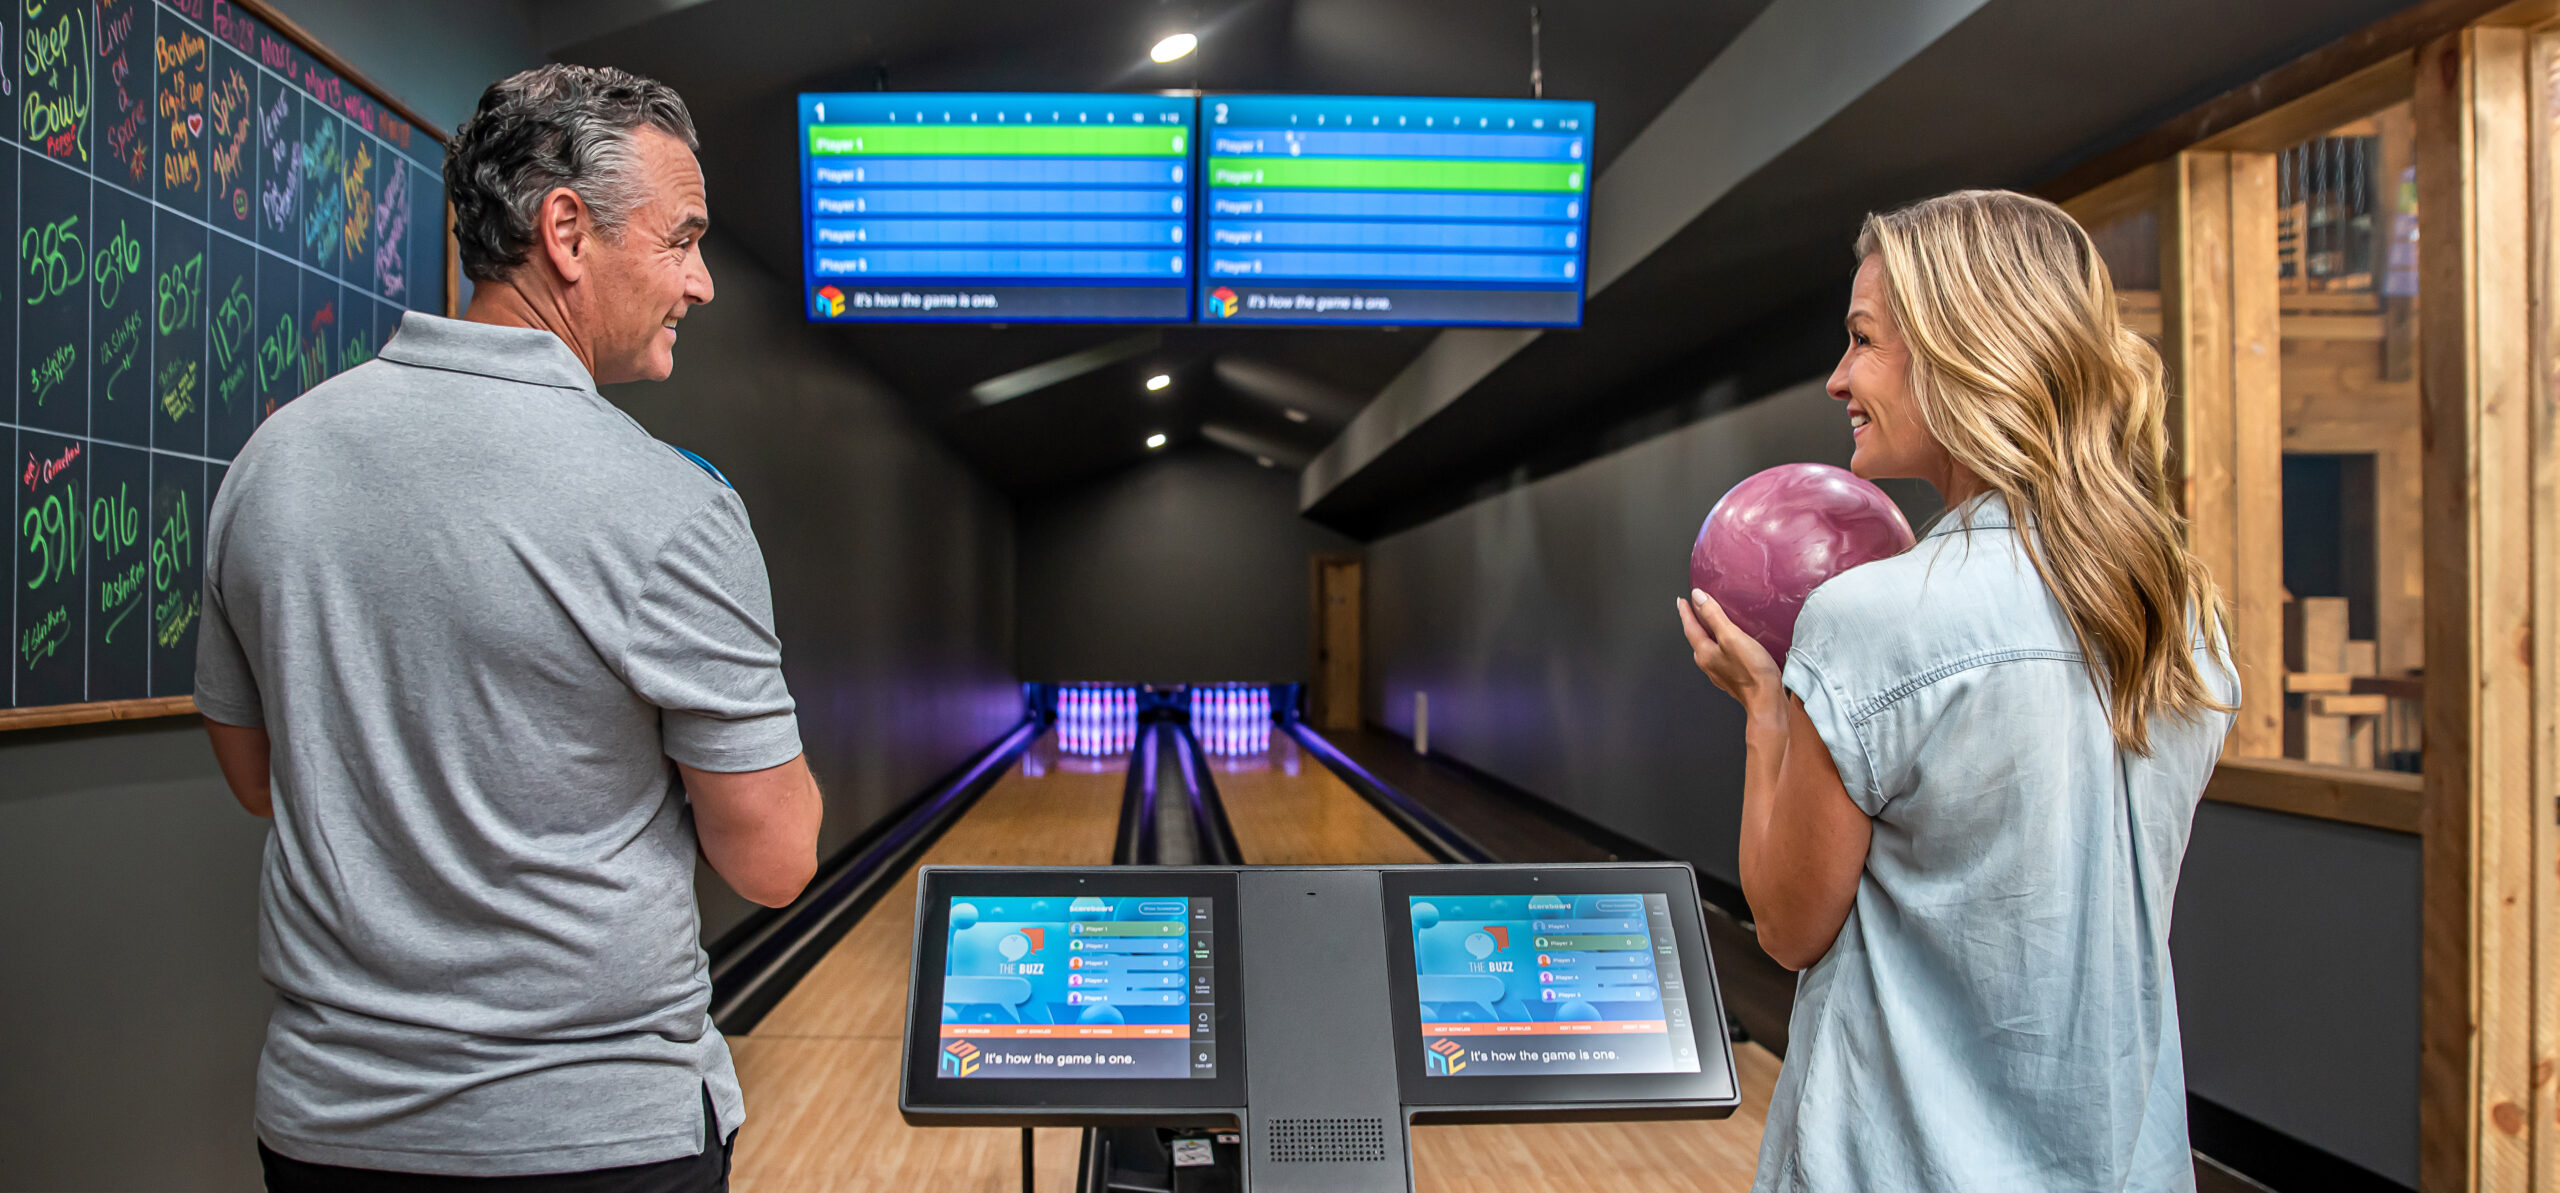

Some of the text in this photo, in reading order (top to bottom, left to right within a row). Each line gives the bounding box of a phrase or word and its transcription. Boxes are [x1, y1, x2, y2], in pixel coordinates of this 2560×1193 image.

[25, 14, 70, 76] Sleep
[814, 101, 827, 123] 1
[1214, 102, 1229, 125] 2
[816, 136, 853, 154] Player
[1216, 138, 1253, 154] Player
[165, 149, 200, 192] Alley
[817, 166, 854, 183] Player
[1215, 168, 1253, 186] Player
[818, 197, 855, 214] Player
[1215, 199, 1252, 215] Player
[819, 228, 856, 244] Player
[1215, 229, 1252, 245] Player
[22, 214, 85, 305] 385
[95, 218, 141, 309] 876
[820, 258, 856, 274] Player
[1214, 259, 1251, 276] Player
[158, 251, 202, 336] 837
[210, 274, 252, 371] 1135
[258, 313, 299, 392] 1312
[93, 481, 138, 561] 916
[23, 483, 77, 590] 391
[153, 489, 192, 592] 874
[1000, 963, 1044, 975] THE BUZZ
[1468, 961, 1514, 973] THE BUZZ
[985, 1052, 1136, 1067] It's how the game is one.
[1470, 1049, 1619, 1063] It's how the game is one.
